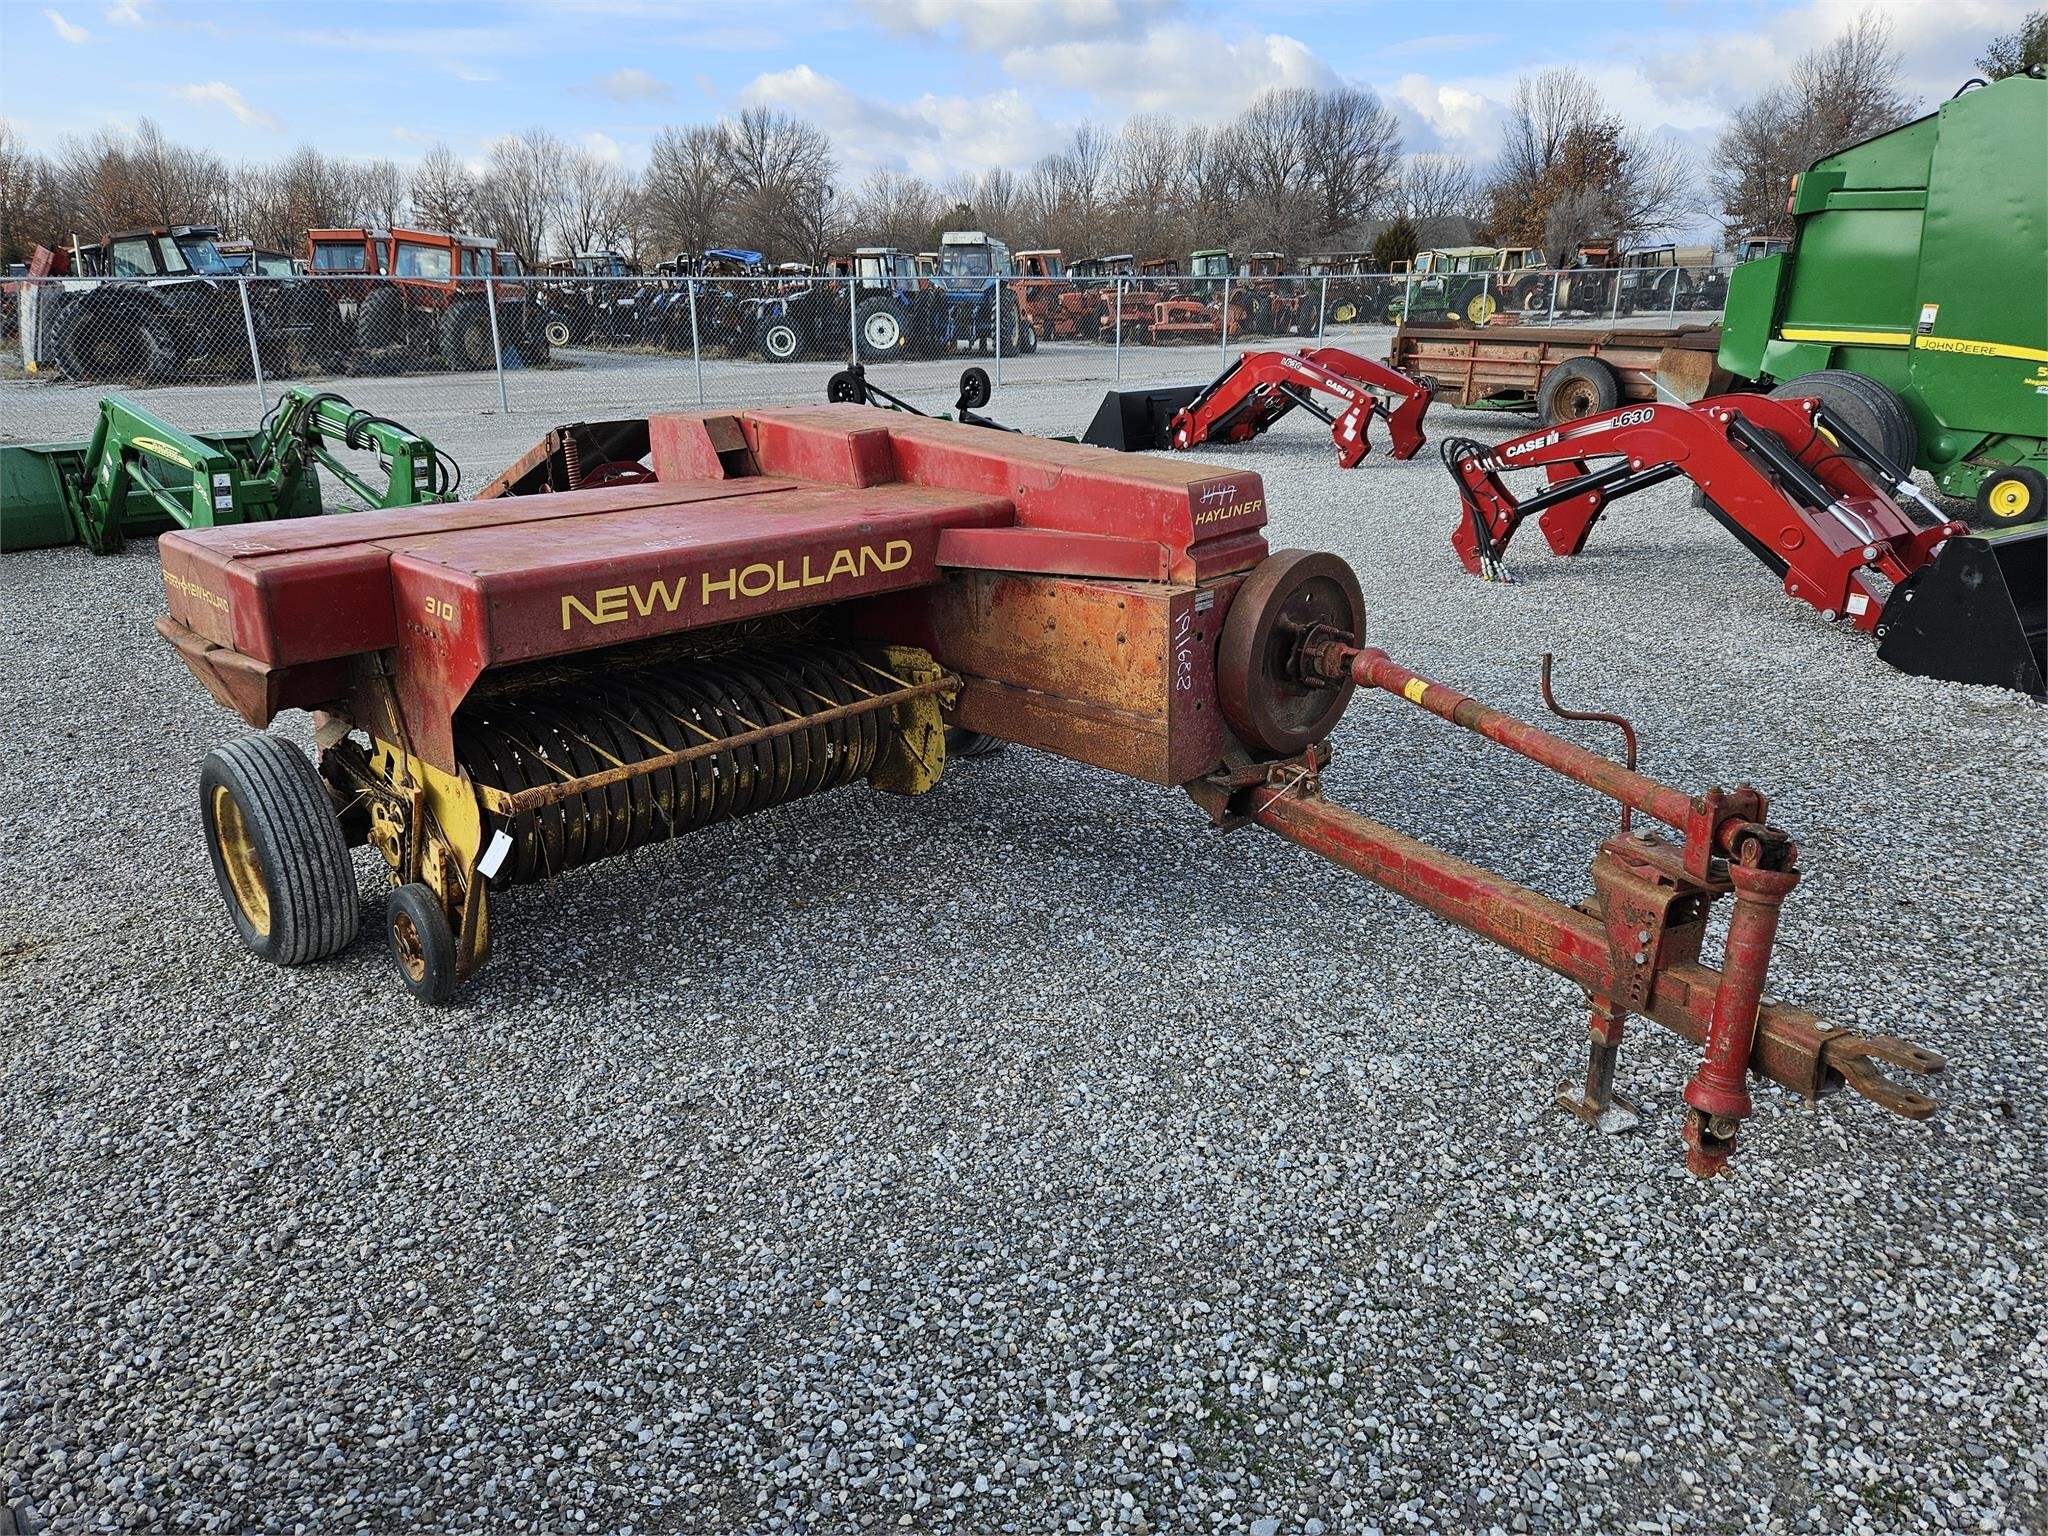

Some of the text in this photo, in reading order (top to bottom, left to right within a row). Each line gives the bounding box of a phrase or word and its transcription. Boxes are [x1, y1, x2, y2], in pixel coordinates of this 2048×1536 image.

[1922, 340, 1997, 355] JOHN DEERE
[1325, 379, 1348, 396] CASE
[1612, 407, 1655, 429] L630
[1506, 436, 1545, 458] CASE
[1195, 499, 1262, 526] HAYLINER
[561, 539, 913, 631] NEW HOLLAND
[425, 596, 453, 622] 310
